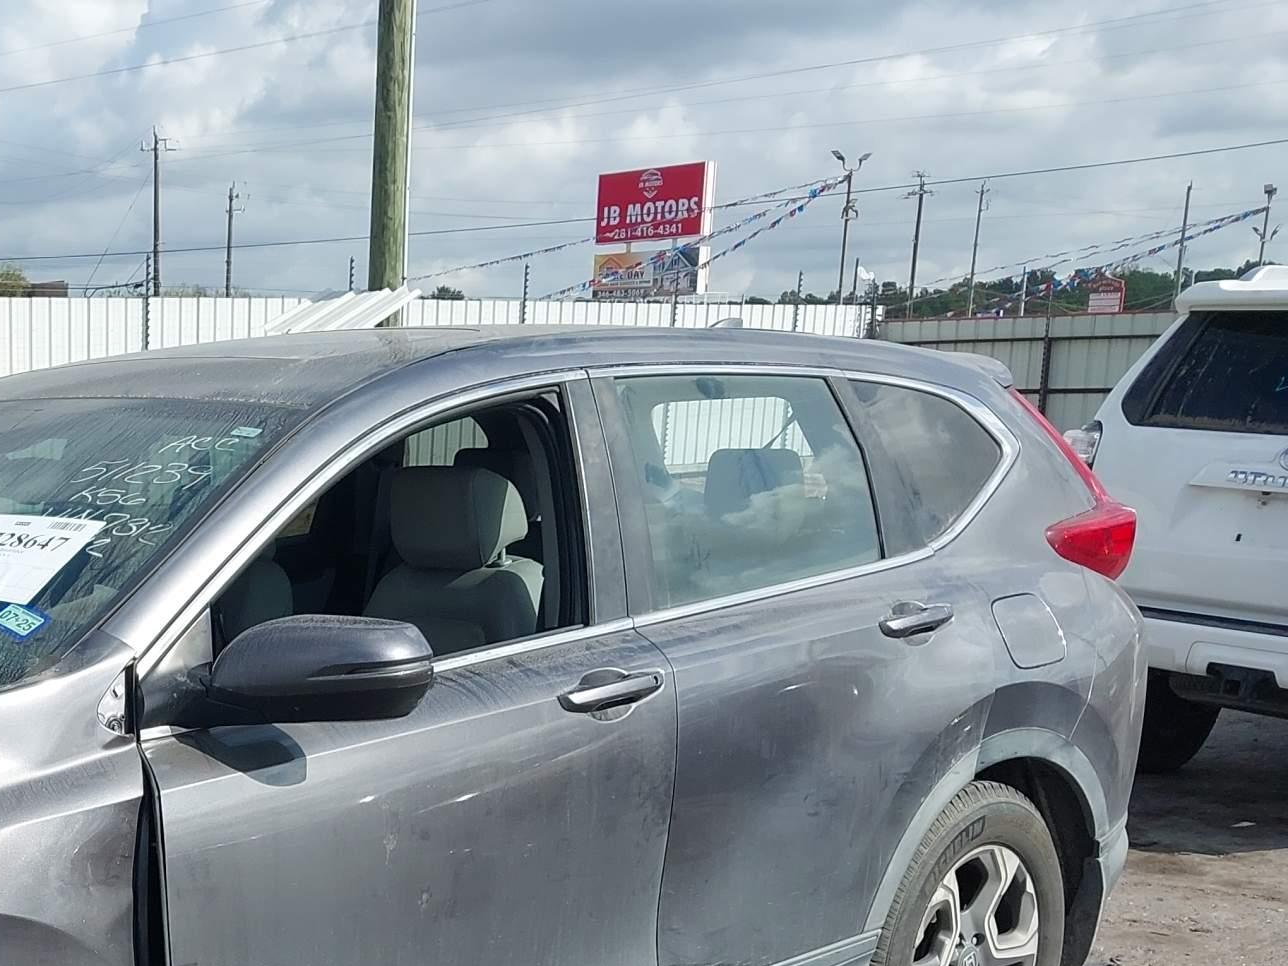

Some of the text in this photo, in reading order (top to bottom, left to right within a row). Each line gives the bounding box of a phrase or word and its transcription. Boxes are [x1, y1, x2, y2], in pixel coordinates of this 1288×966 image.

[601, 197, 699, 227] JB MOTORS
[614, 223, 682, 240] 281-416-4341
